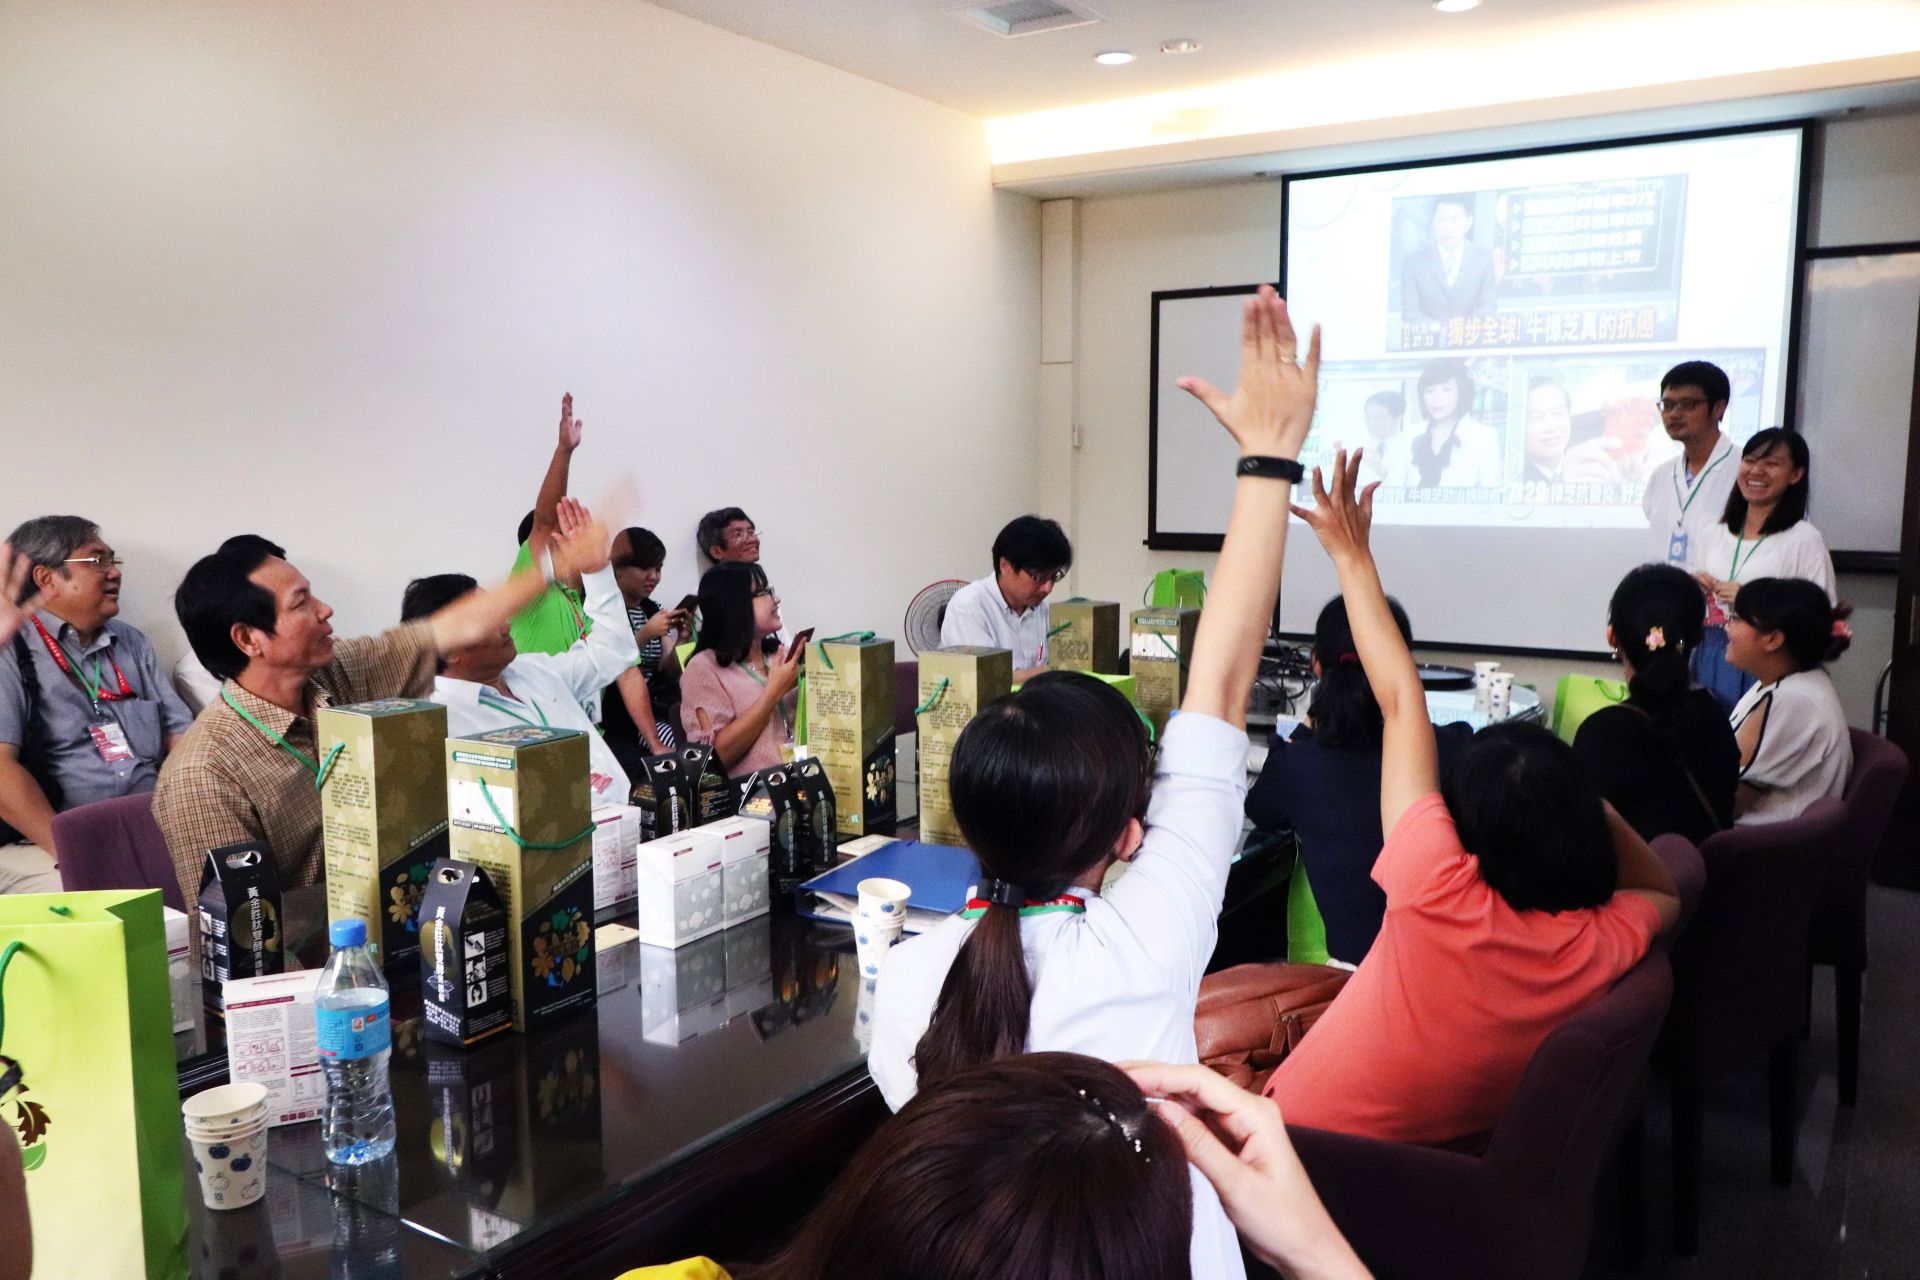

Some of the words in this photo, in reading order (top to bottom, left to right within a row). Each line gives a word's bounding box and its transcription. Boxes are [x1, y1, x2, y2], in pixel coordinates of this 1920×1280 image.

[1526, 309, 1655, 344] 牛樟芝真的抗癌
